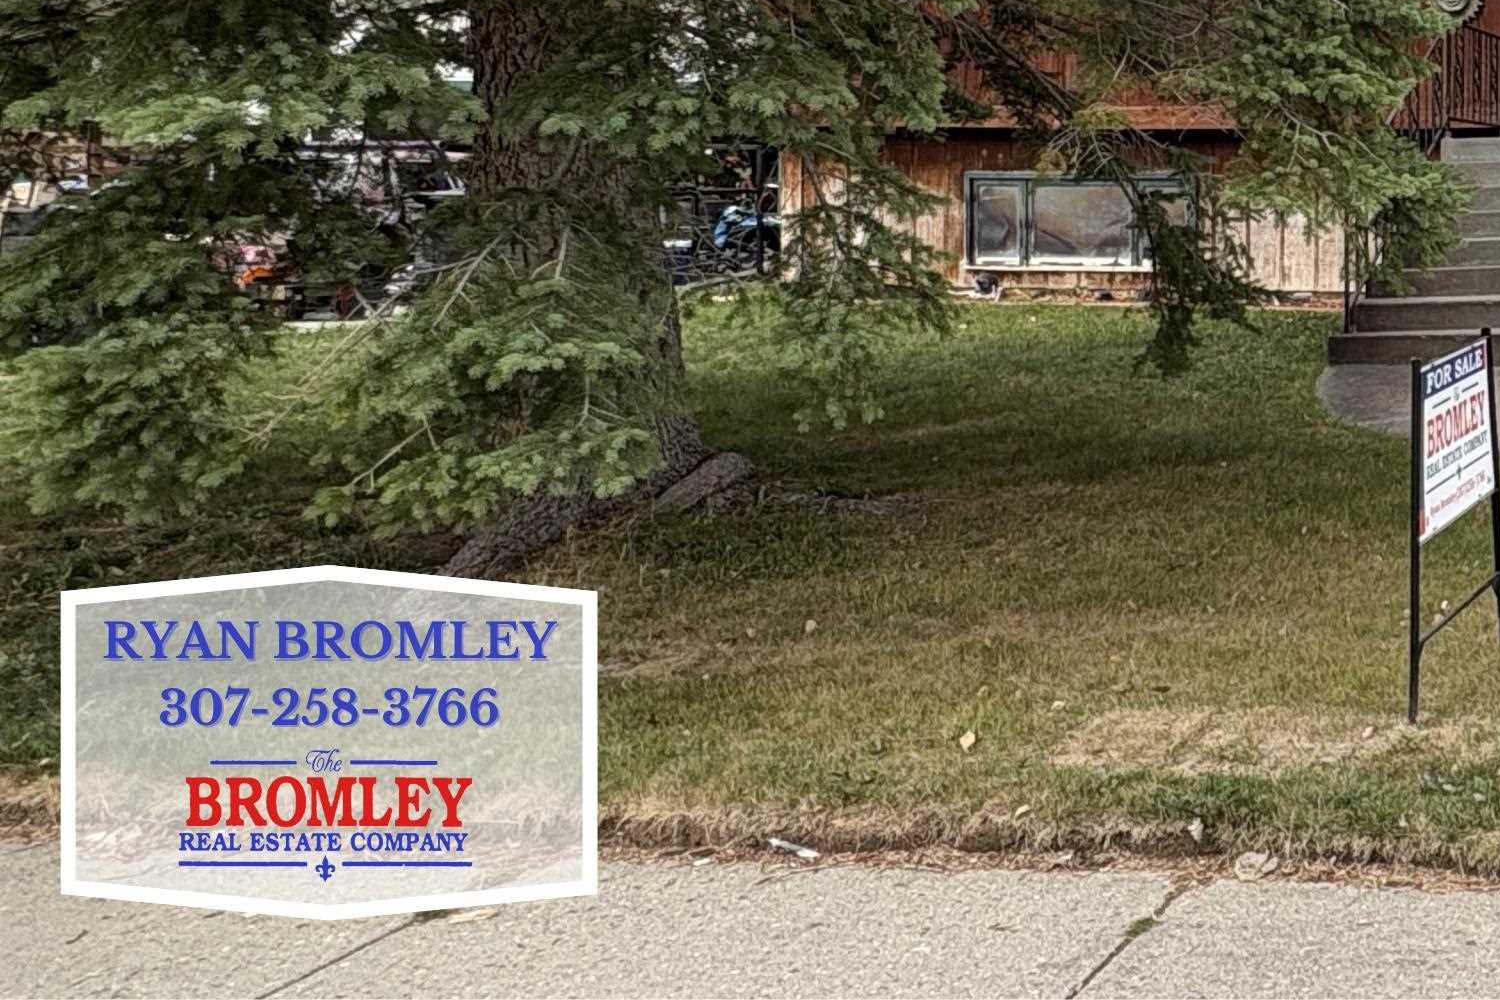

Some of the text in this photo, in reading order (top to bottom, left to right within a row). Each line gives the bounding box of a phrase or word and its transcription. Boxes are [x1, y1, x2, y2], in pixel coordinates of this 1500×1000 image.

[1426, 363, 1452, 395] FOR
[1454, 348, 1483, 379] SALE
[1426, 390, 1485, 458] BROMLEY
